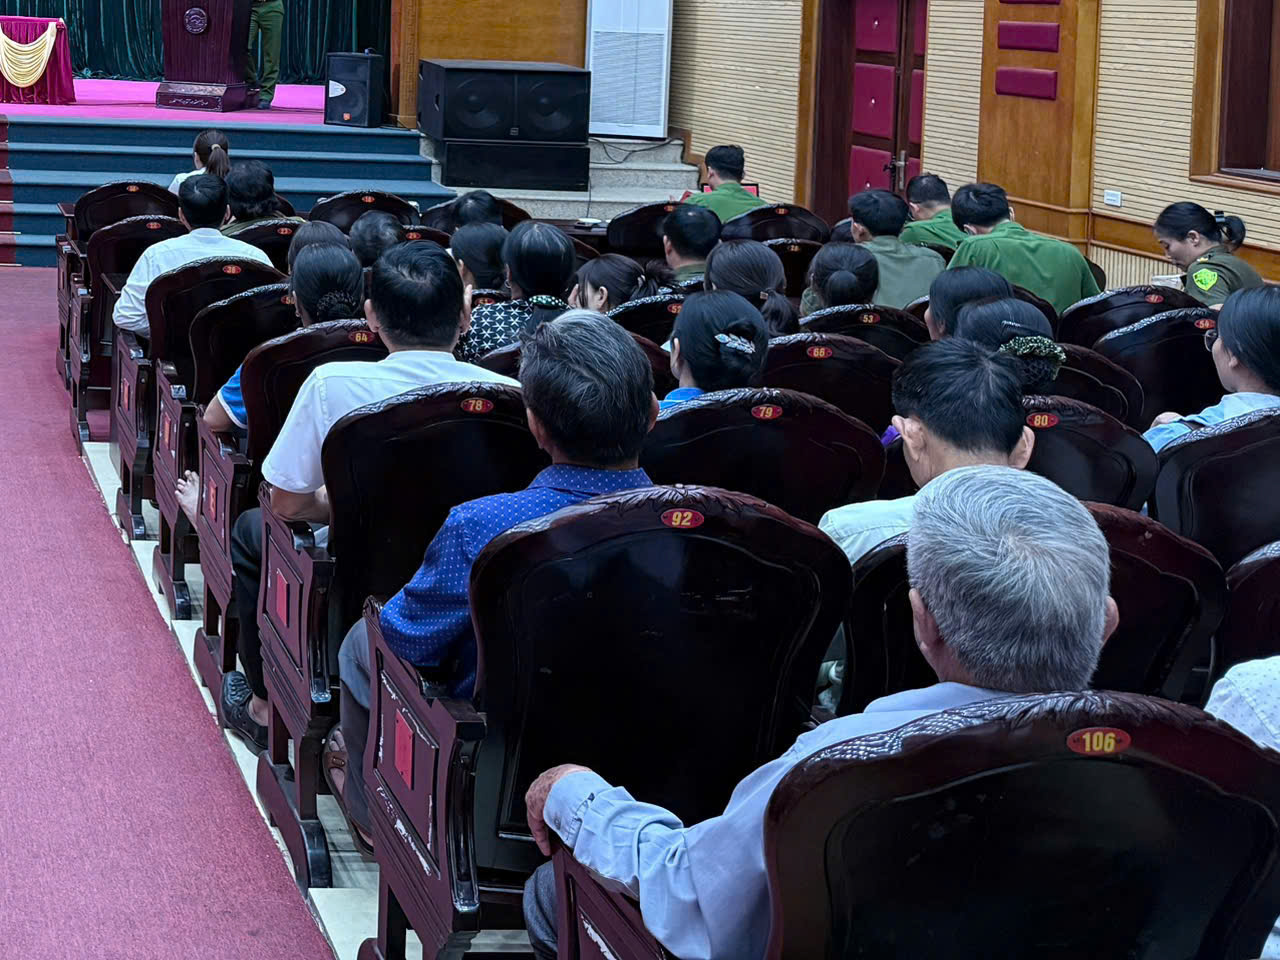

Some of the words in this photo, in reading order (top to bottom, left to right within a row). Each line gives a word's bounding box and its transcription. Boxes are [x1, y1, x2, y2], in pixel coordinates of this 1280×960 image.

[862, 314, 873, 324] 53
[355, 333, 368, 342] 64
[813, 347, 825, 357] 66
[468, 400, 482, 411] 78
[759, 407, 773, 418] 79
[1034, 415, 1048, 426] 80
[672, 512, 692, 526] 92
[1082, 732, 1116, 752] 106
